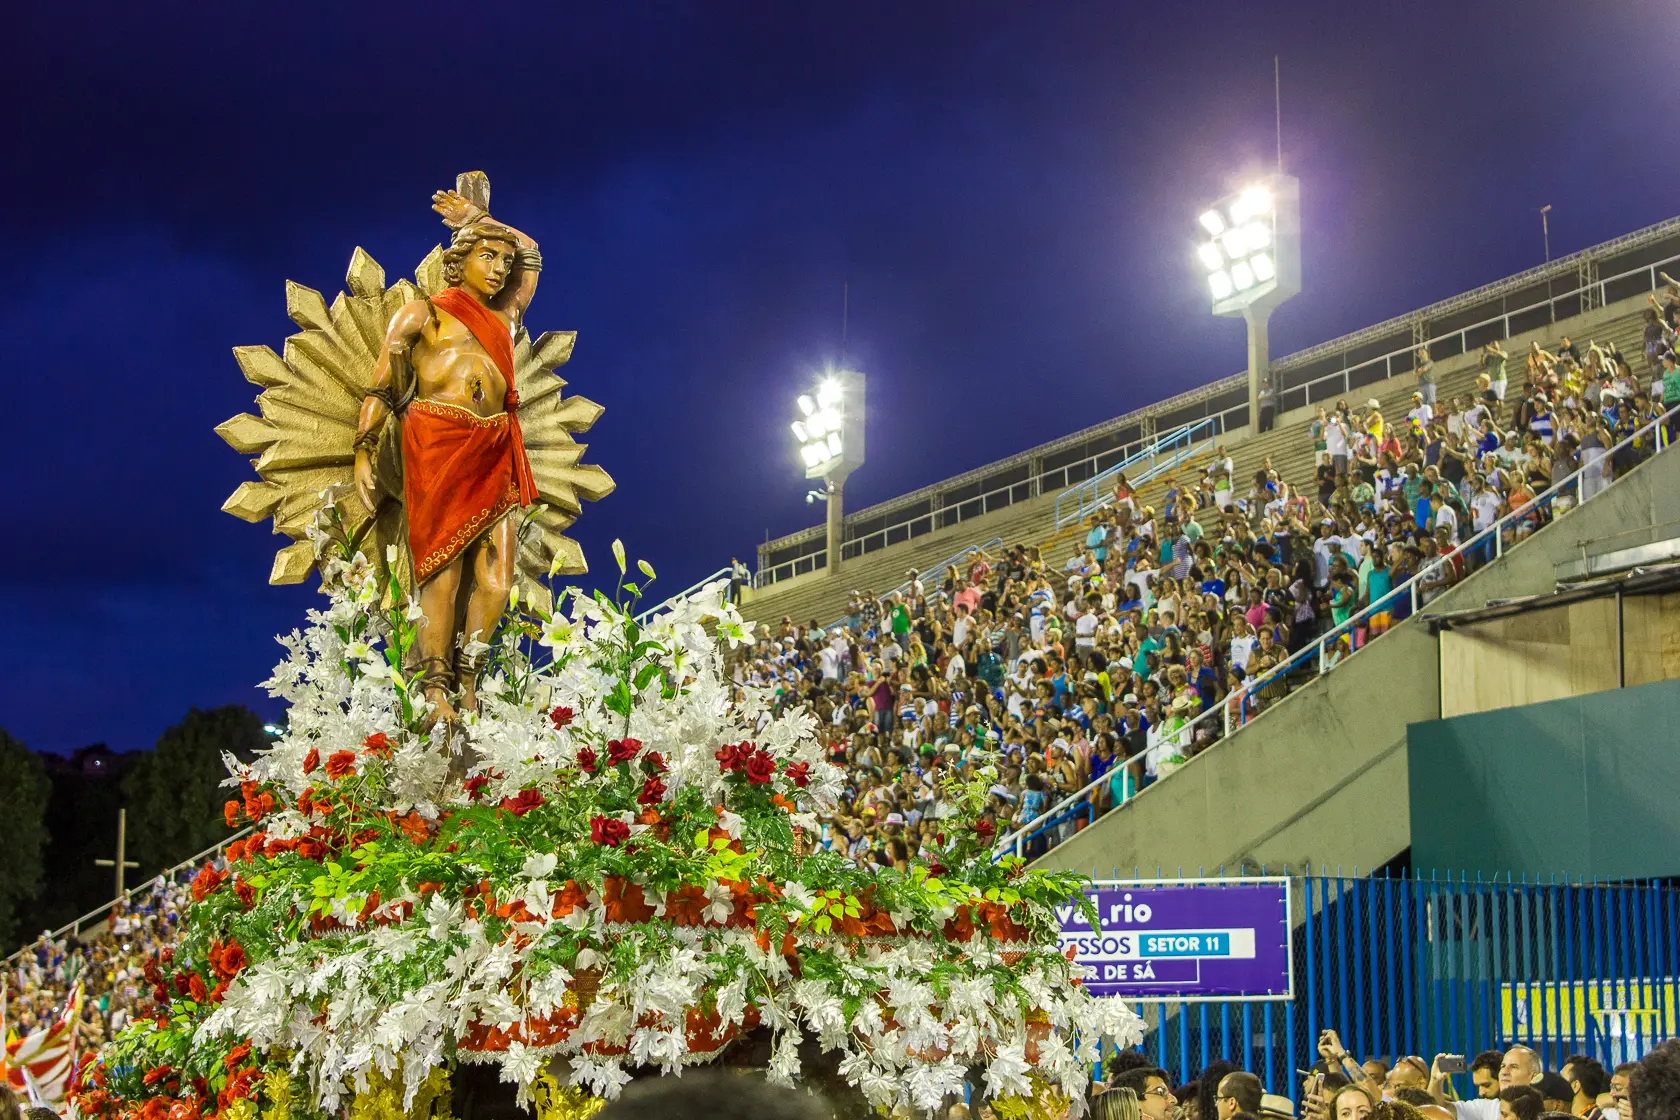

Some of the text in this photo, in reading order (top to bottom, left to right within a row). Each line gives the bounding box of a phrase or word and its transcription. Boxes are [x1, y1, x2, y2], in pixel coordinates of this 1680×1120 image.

[1147, 937, 1200, 952] SETOR
[1205, 936, 1219, 951] 11
[1104, 964, 1127, 980] DE
[1133, 960, 1156, 980] SÁ
